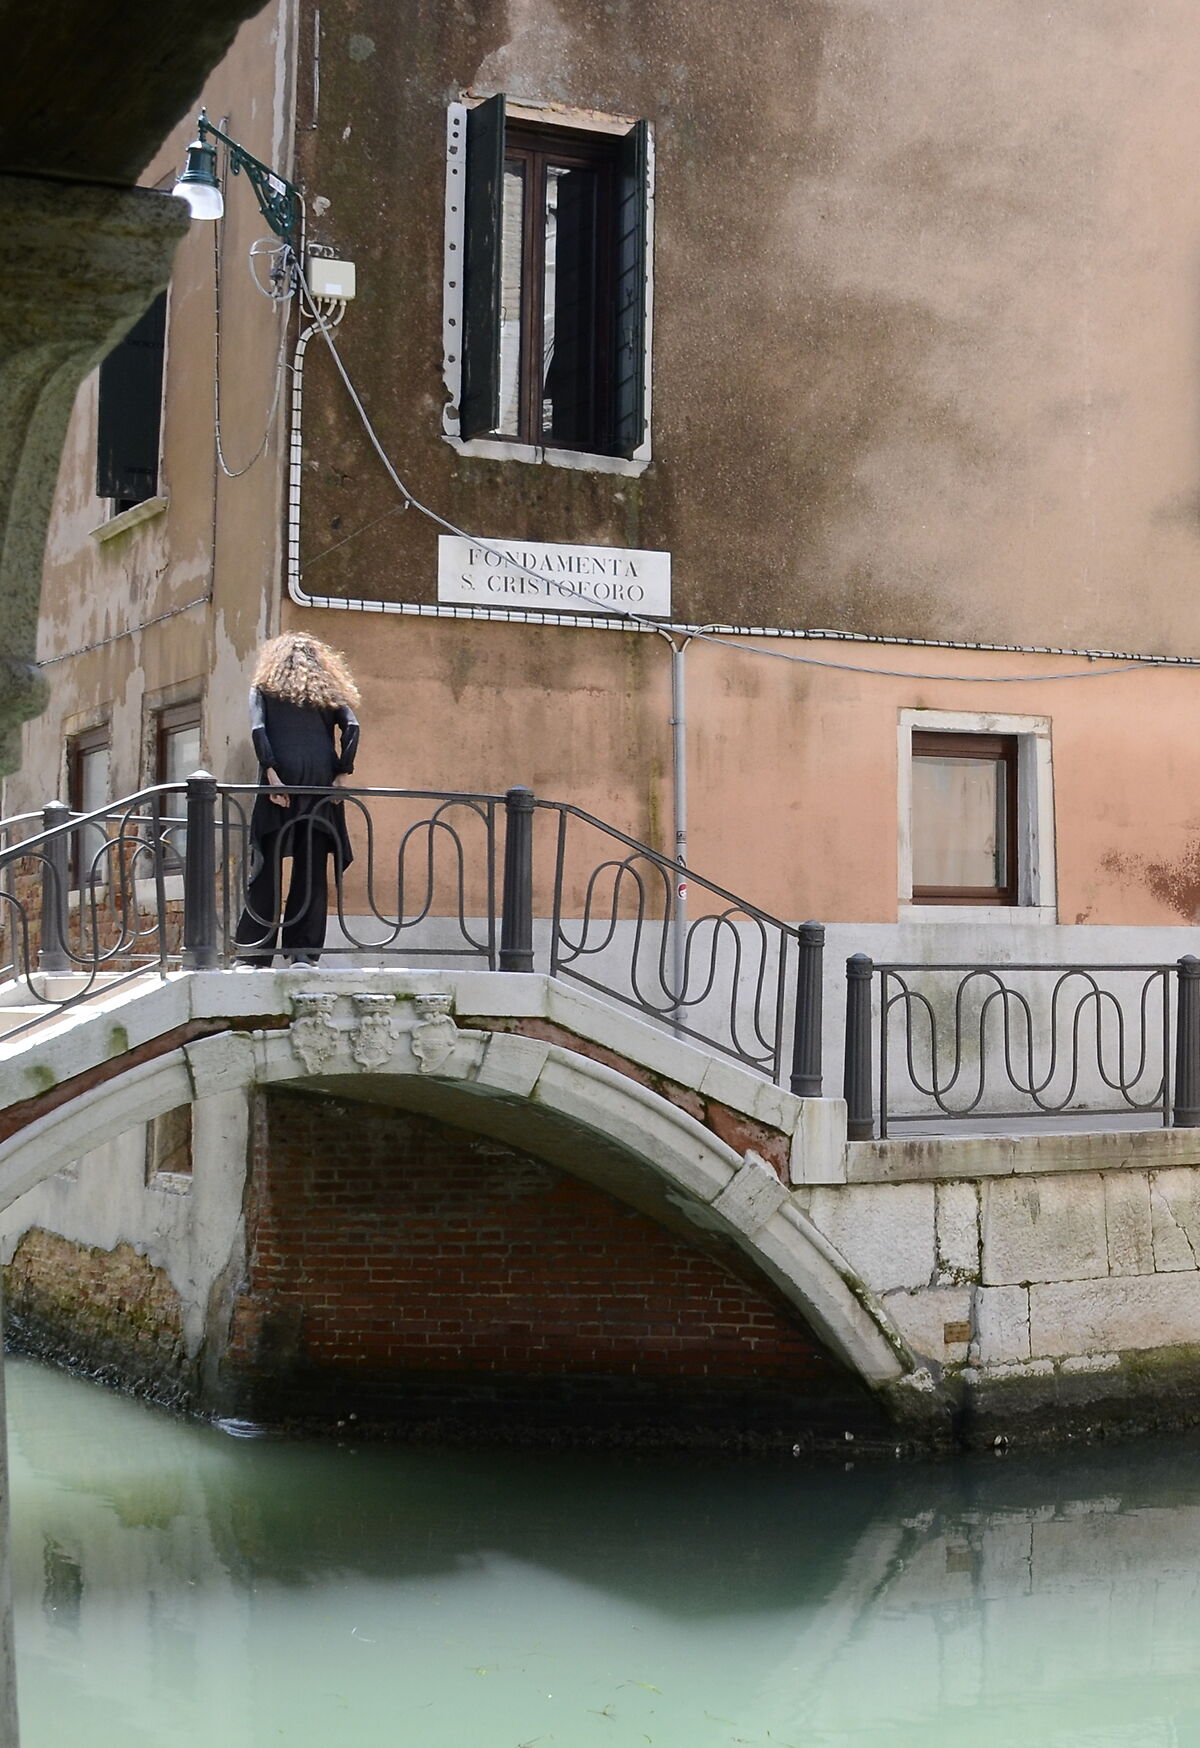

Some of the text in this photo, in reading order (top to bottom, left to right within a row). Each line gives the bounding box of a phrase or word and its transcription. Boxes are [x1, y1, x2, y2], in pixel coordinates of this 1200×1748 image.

[468, 548, 640, 578] FONDAMENTA
[460, 573, 645, 602] S. CRISTOFORO
